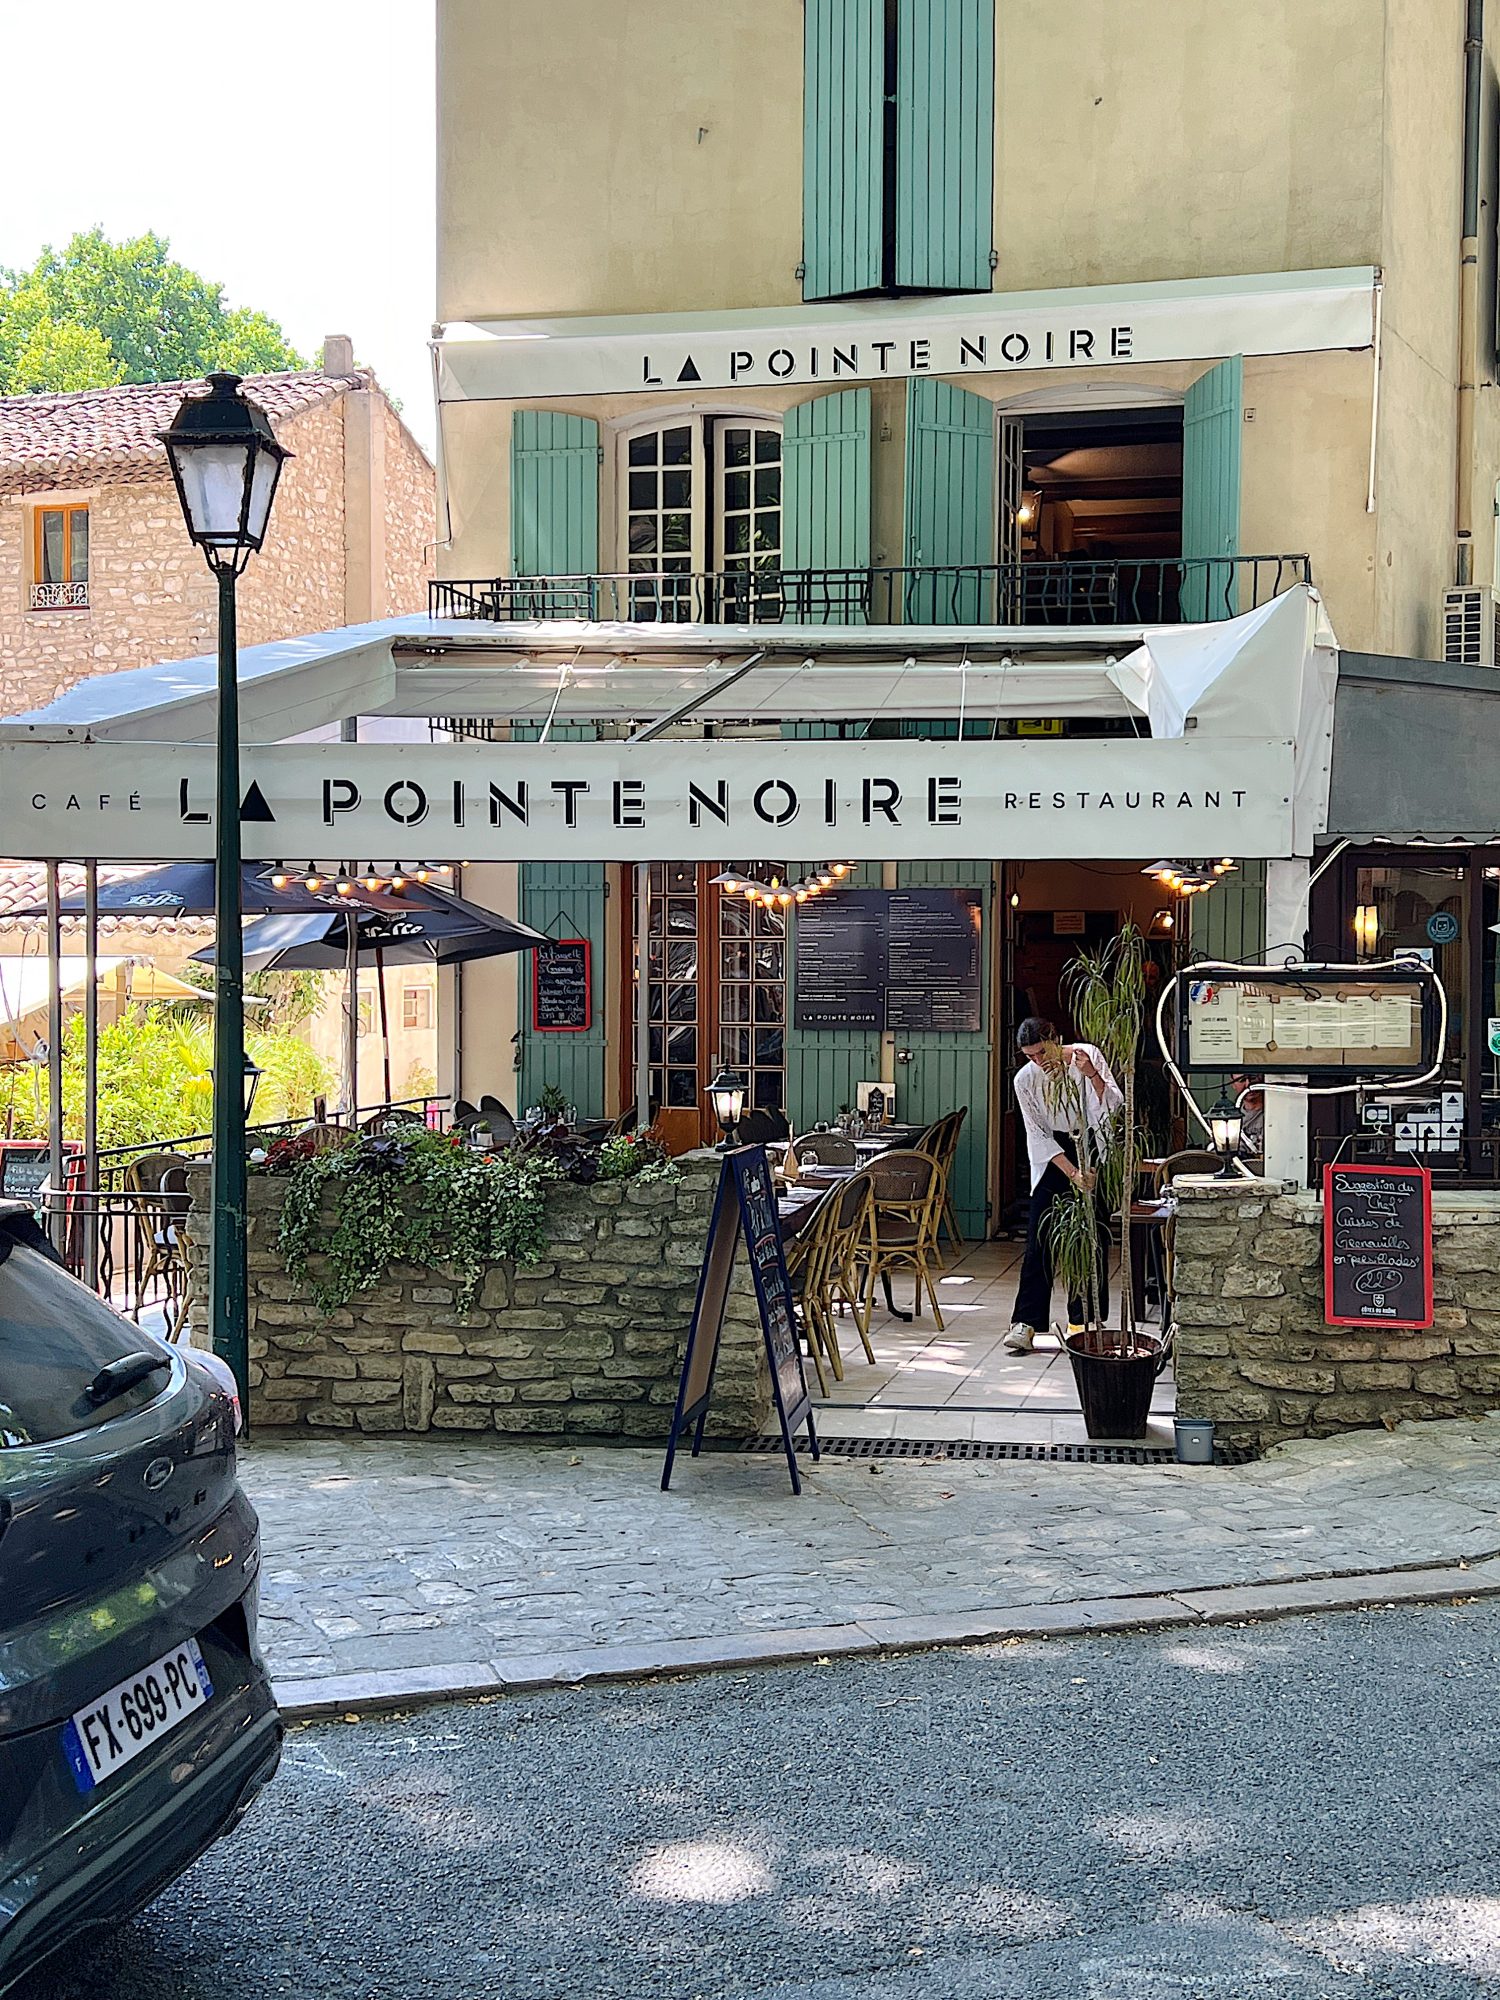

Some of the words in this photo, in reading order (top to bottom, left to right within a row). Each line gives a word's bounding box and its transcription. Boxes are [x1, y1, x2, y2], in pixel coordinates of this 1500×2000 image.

[644, 354, 703, 384] LA
[730, 340, 931, 382] POINTE
[960, 327, 1133, 367] NOIRE
[31, 789, 142, 811] CAFÉ
[180, 777, 277, 825] LA
[323, 779, 647, 829] POINTE
[689, 777, 963, 828] NOIRE
[1004, 791, 1248, 809] RESTAURANT
[1397, 1181, 1415, 1193] du
[1336, 1206, 1379, 1229] Cuisses
[1385, 1217, 1405, 1229] de
[1335, 1229, 1411, 1250] Grenouilles
[1334, 1256, 1346, 1265] en
[82, 1653, 198, 1770] FX-699-PC
